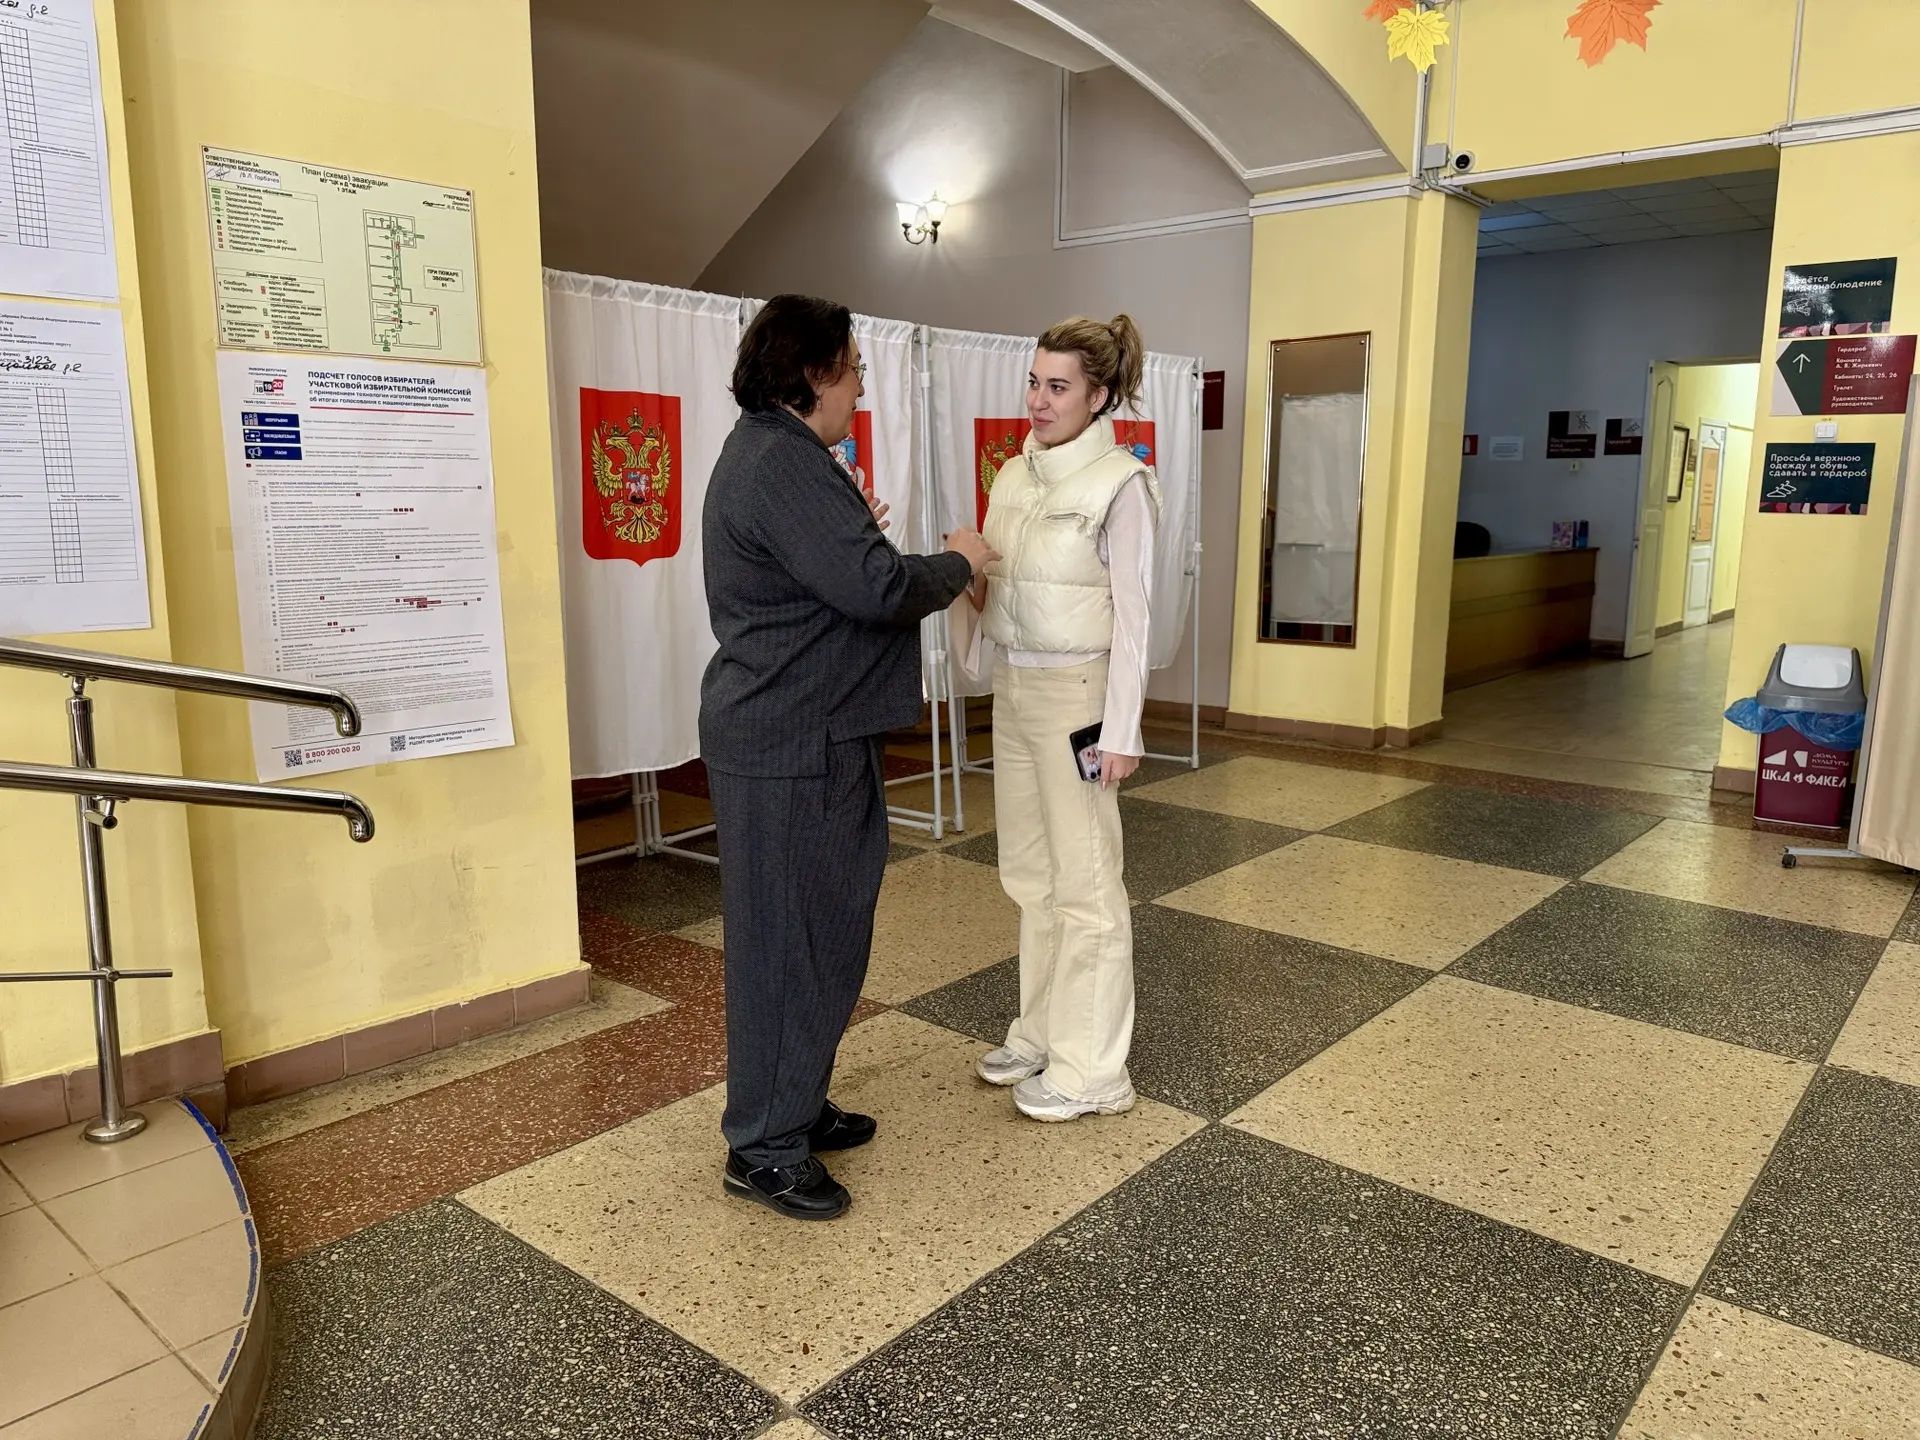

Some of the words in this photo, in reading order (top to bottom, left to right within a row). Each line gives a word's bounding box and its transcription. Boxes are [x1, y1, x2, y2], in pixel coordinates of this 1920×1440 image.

[206, 155, 252, 166] ОТВЕТСТВЕННЫЙ
[238, 166, 279, 176] БЕЗОПАСНОСТЬ
[302, 166, 321, 176] План
[323, 171, 350, 182] (схема)
[352, 176, 388, 187] эвакуации
[23, 356, 52, 365] 3123
[308, 371, 345, 380] ПОДСЧЕТ
[346, 374, 382, 382] ГОЛОСОВ
[384, 376, 436, 385] ИЗБИРАТЕЛЕЙ
[256, 386, 264, 394] 18
[264, 383, 272, 391] 19
[308, 380, 362, 390] УЧАСТКОВОЙ
[364, 384, 426, 393] ИЗБИРАТЕЛЬНОЙ
[428, 388, 472, 396] КОМИССИЕЙ
[1770, 454, 1810, 464] Просьба
[1814, 455, 1861, 464] верхнюю
[1770, 462, 1806, 470] одежду
[1820, 461, 1848, 470] обувь
[1820, 468, 1868, 478] гардероб
[1806, 774, 1847, 788] ФАКЕЛ
